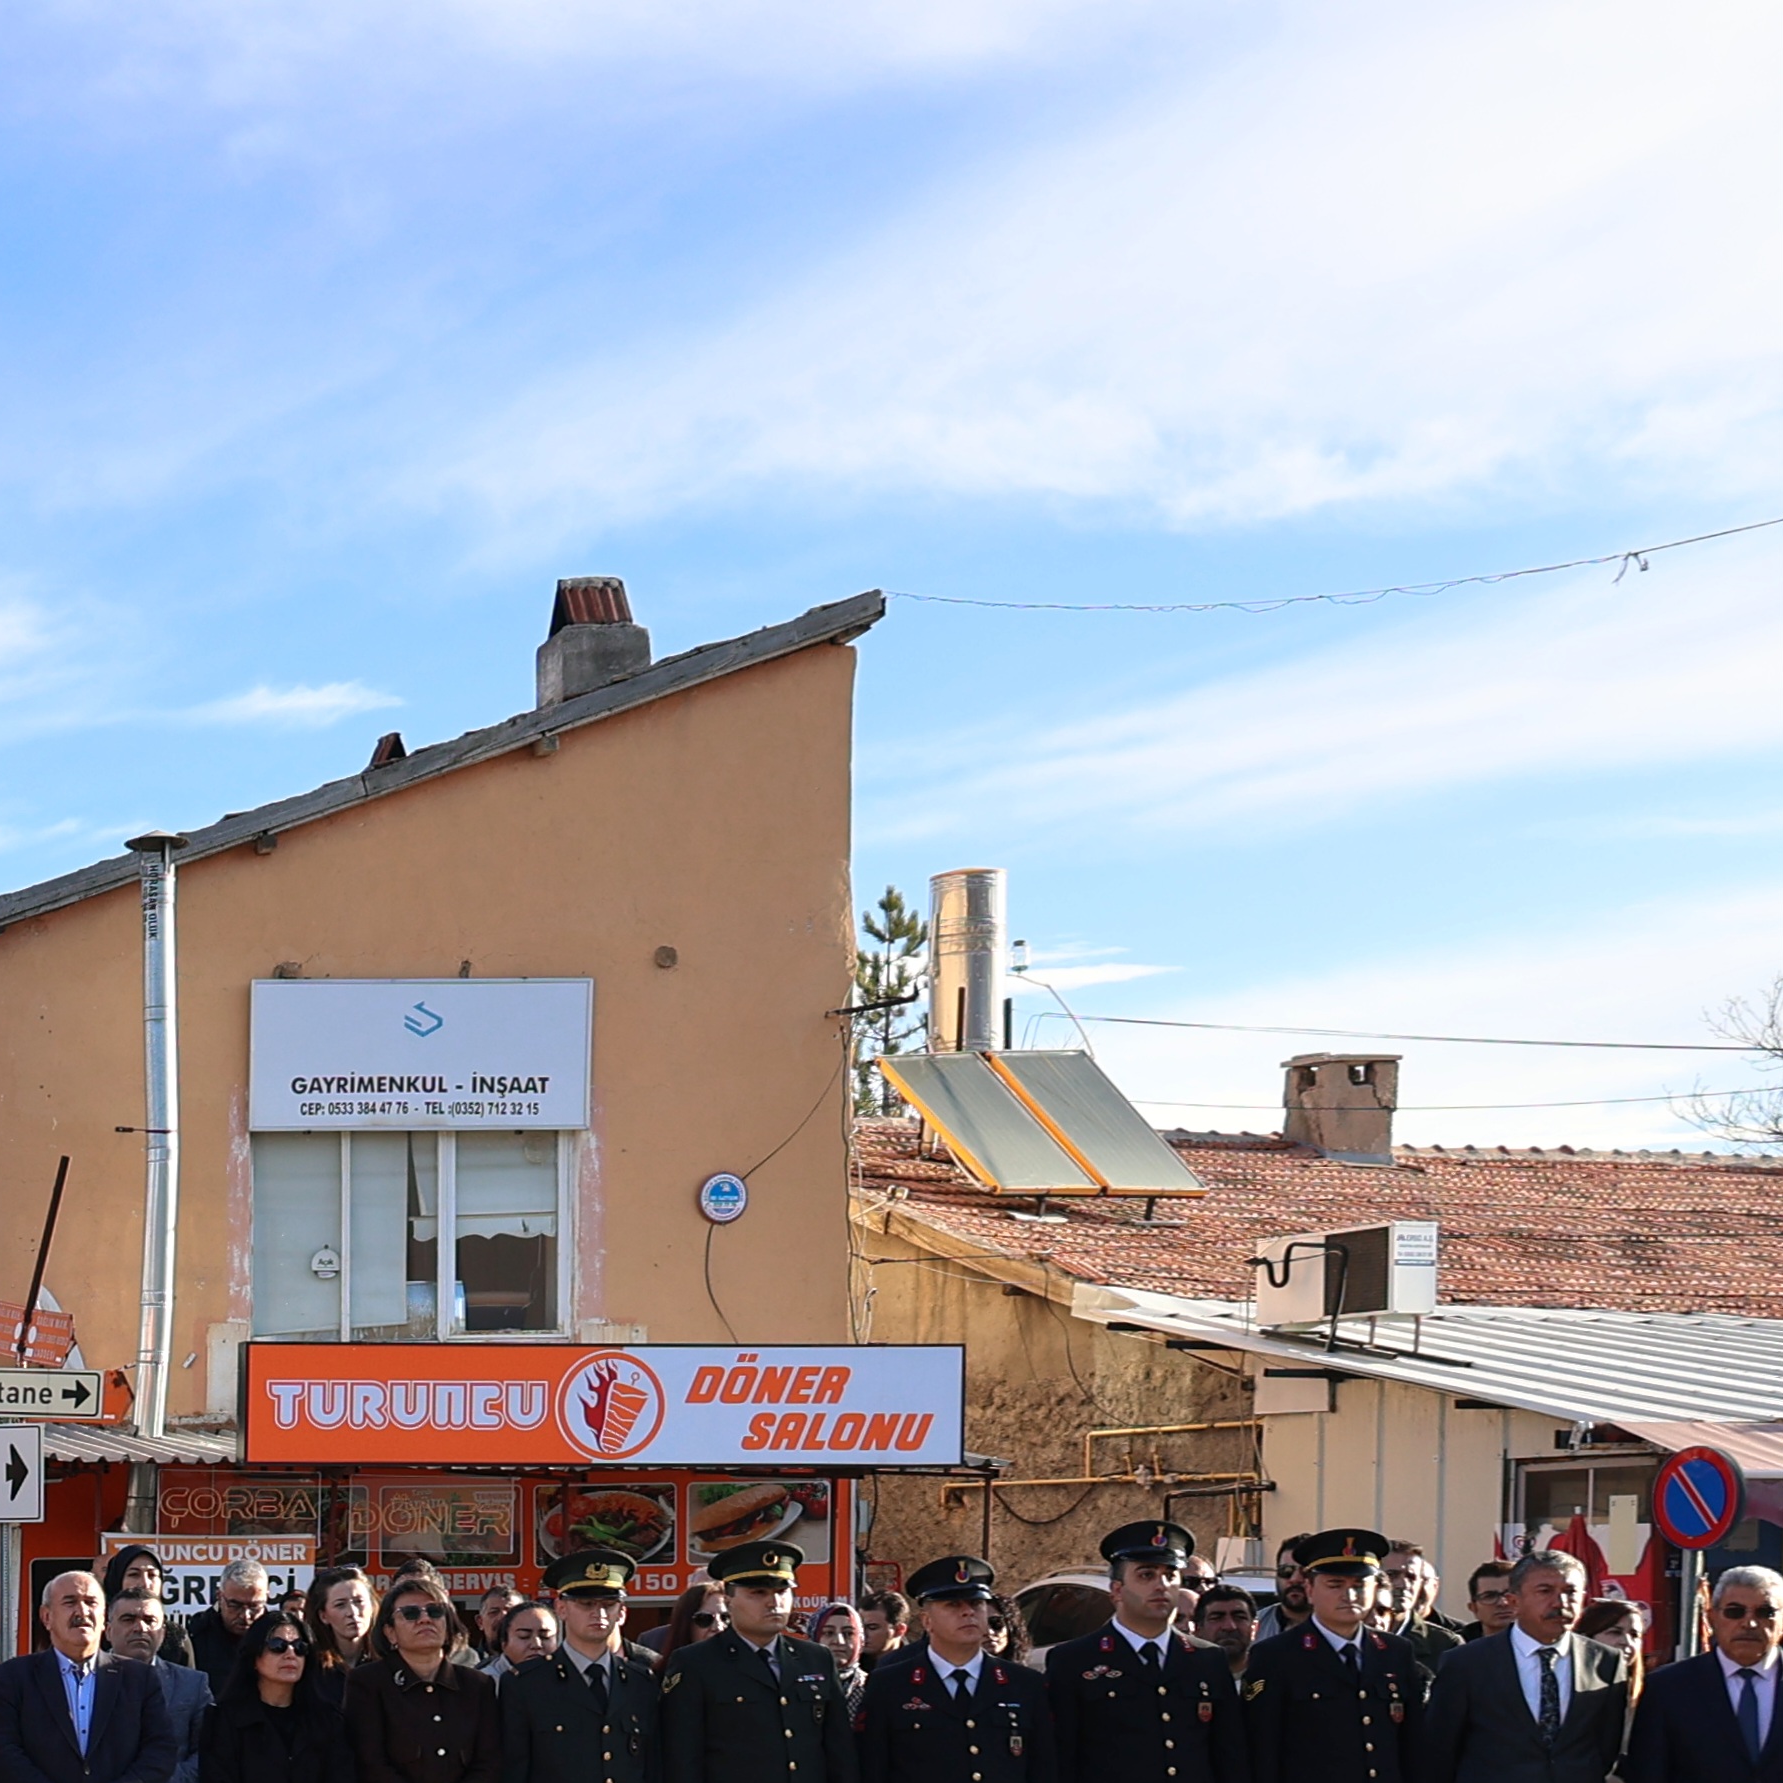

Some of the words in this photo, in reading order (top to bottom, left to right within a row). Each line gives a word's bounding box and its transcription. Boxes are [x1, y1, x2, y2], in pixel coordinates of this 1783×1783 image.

[148, 913, 158, 939] OLUK
[291, 1071, 448, 1094] GAYRİMENKUL
[472, 1071, 550, 1098] İNŞAAT
[300, 1102, 325, 1116] CEP:
[328, 1102, 354, 1115] 0533
[357, 1102, 377, 1115] 384
[379, 1102, 393, 1115] 47
[396, 1102, 408, 1115] 76
[425, 1102, 445, 1115] TEL
[488, 1102, 507, 1115] 712
[510, 1102, 527, 1115] 32
[527, 1102, 539, 1115] 15
[684, 1353, 851, 1406] DÖNER
[266, 1379, 549, 1432] TURUNCU
[742, 1413, 934, 1451] SALONU
[160, 1487, 317, 1528] ÇORBA
[350, 1494, 511, 1536] DÖNER
[228, 1540, 306, 1561] DÖNER
